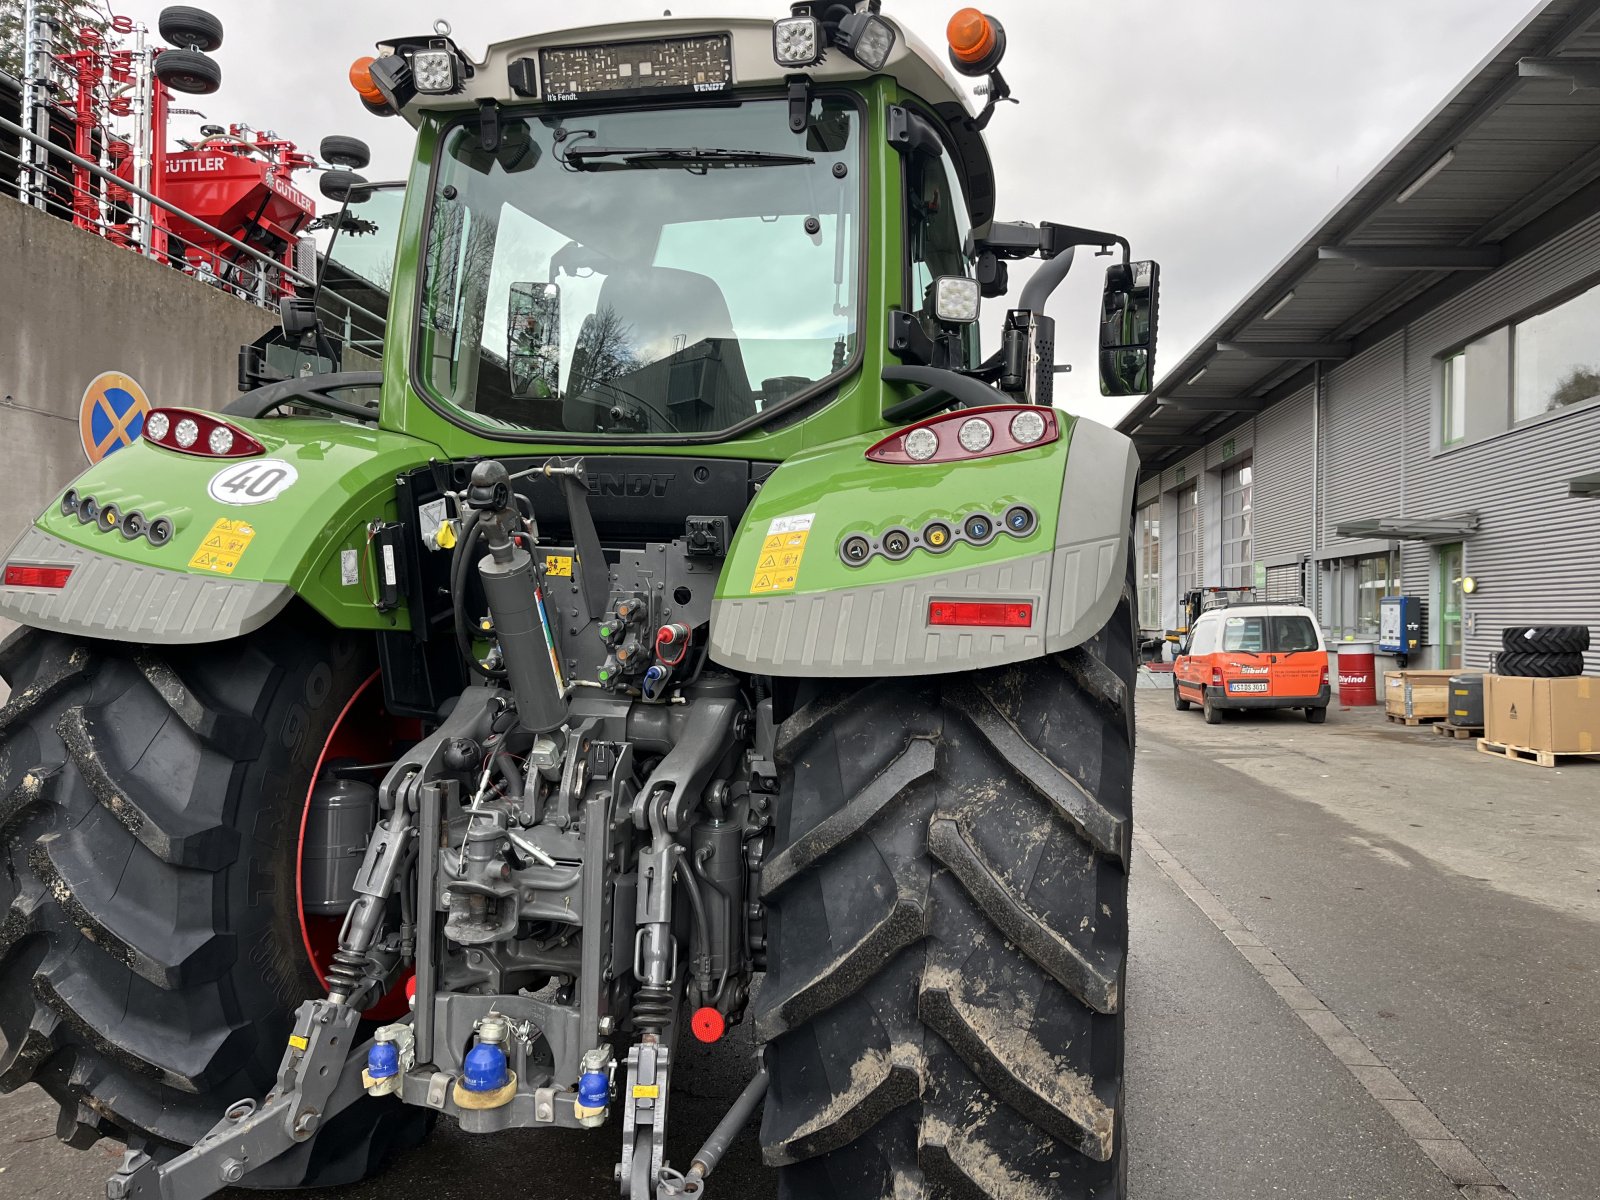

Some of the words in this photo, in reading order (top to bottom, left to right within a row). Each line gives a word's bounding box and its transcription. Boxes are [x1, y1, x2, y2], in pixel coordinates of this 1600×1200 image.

[547, 93, 557, 102] It's
[557, 93, 578, 101] Fendt.
[693, 82, 726, 92] FENDT
[275, 179, 312, 212] GÜTTLER
[221, 465, 288, 497] 40
[566, 472, 677, 497] ENDT
